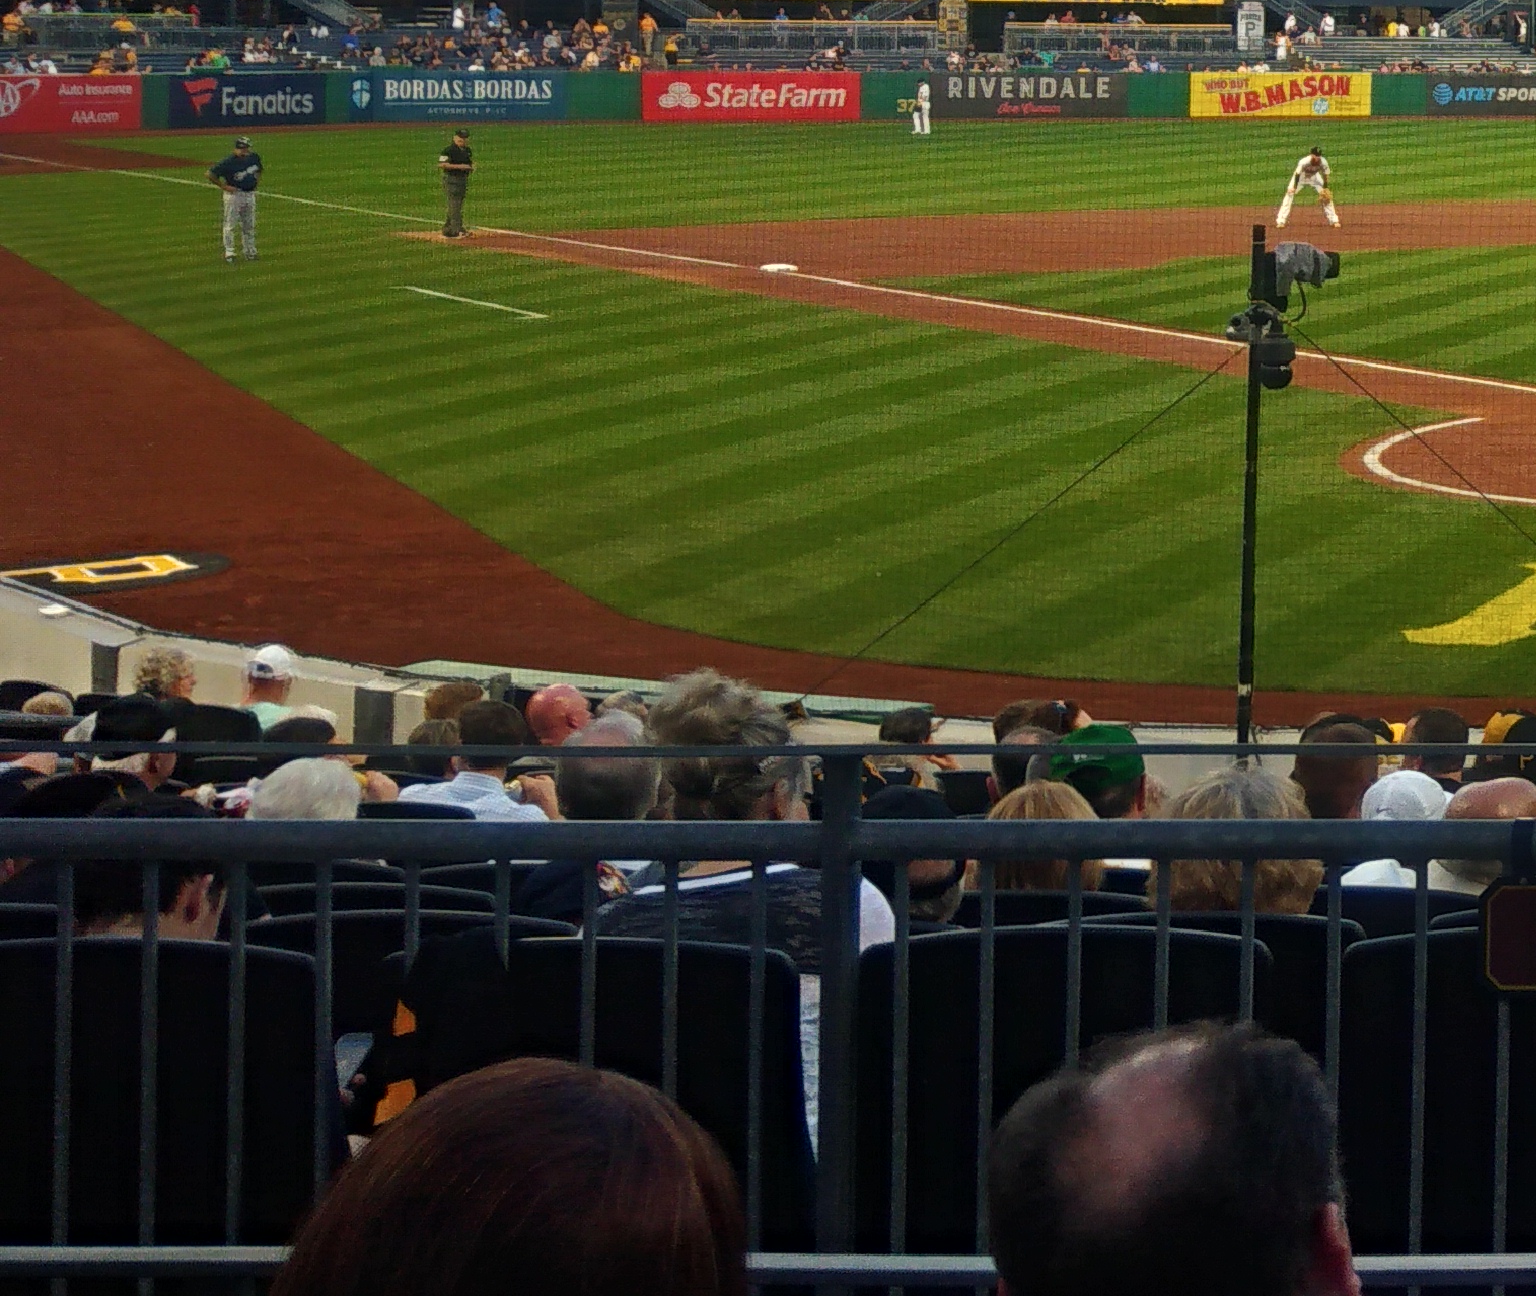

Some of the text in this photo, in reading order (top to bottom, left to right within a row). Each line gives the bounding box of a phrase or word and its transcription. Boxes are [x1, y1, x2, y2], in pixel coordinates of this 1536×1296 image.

[58, 83, 133, 97] Auto Insurance
[384, 79, 553, 101] BORDAS BORDAS
[948, 76, 1112, 100] RIVENDALE
[1204, 78, 1250, 92] WHO BUT
[221, 86, 314, 116] Fanatics
[1455, 87, 1497, 102] AT&T
[71, 109, 120, 124] AAA.com
